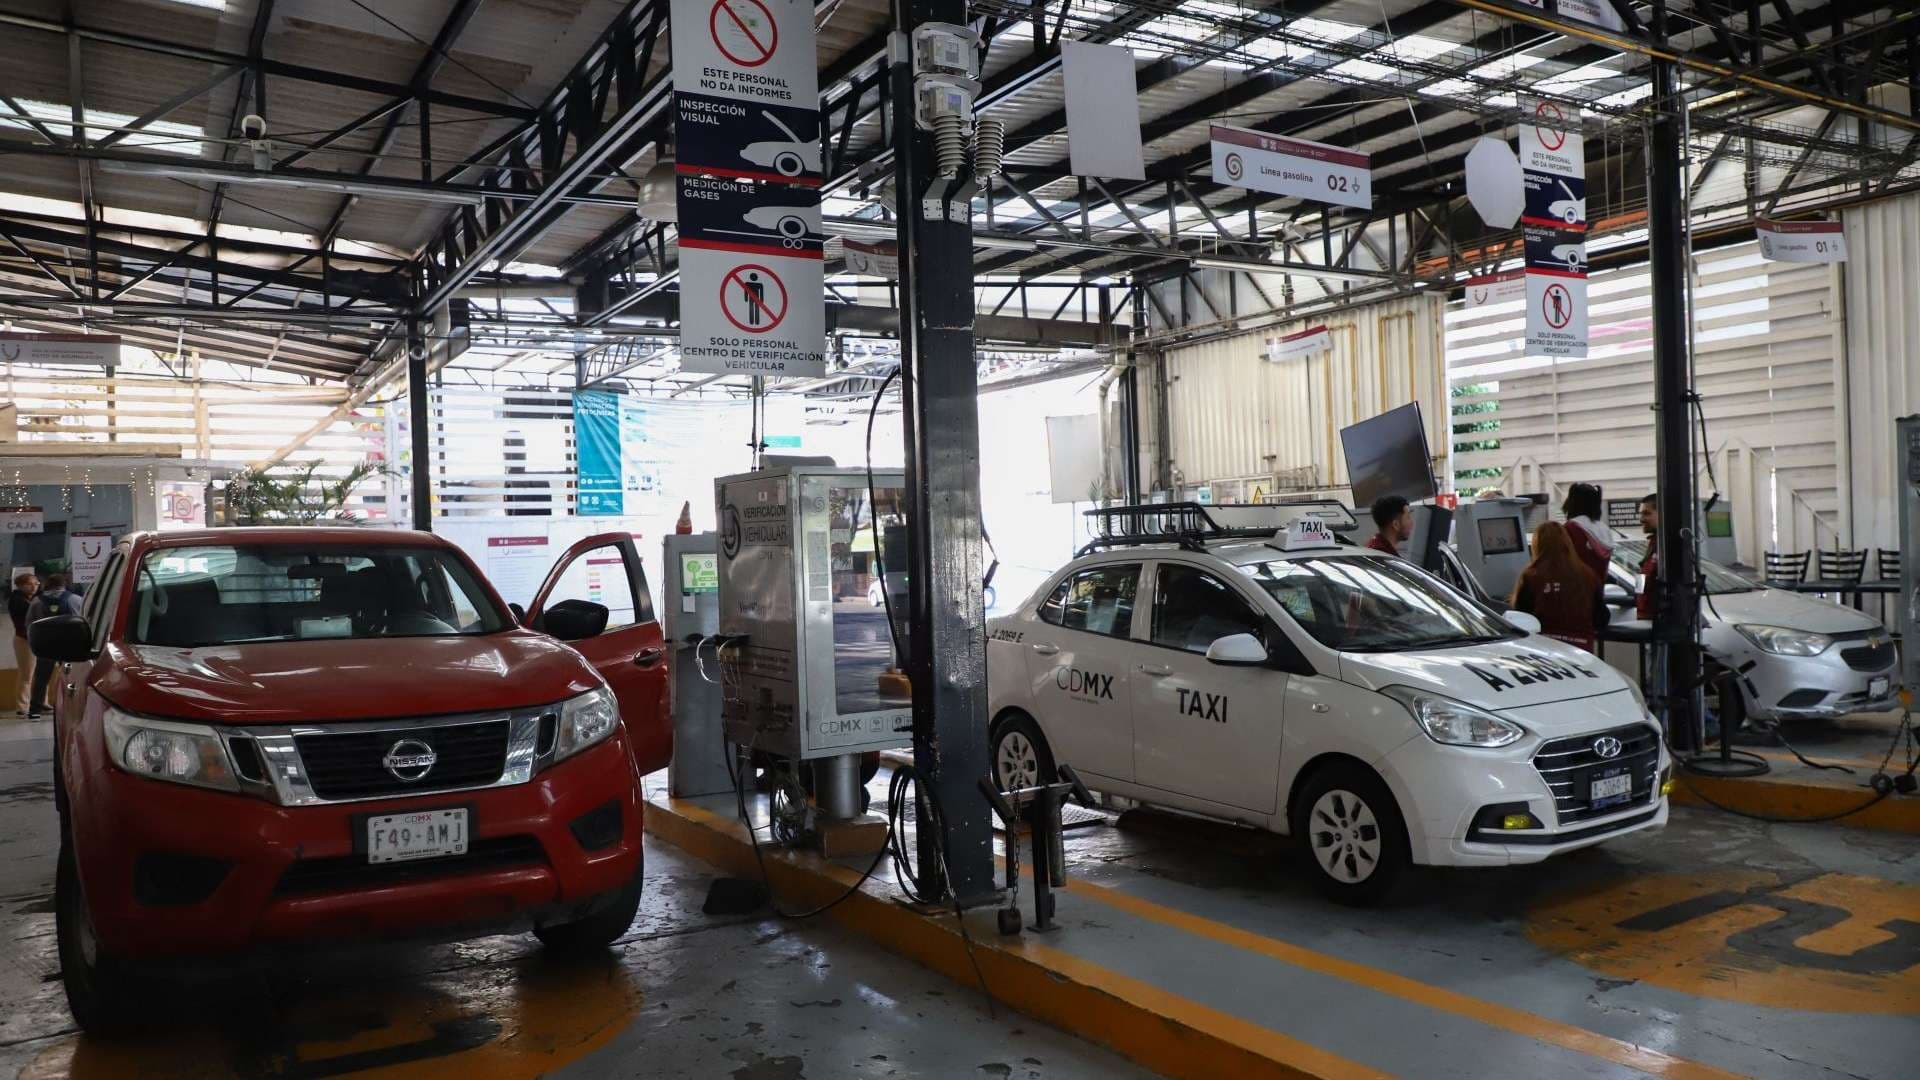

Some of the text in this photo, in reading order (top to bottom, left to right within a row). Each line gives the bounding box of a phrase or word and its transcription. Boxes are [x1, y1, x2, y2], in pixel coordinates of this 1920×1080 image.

[703, 67, 789, 89] ESTE PERSONAL
[700, 79, 792, 100] NO DA INFORMES
[680, 98, 746, 117] INSPECCIÓN
[680, 111, 720, 125] VISUAL
[1546, 153, 1571, 164] PERSONAL
[1548, 162, 1573, 173] INFORMES
[683, 178, 756, 194] MEDICIÓN DE
[1282, 170, 1314, 183] gasolina
[1327, 174, 1348, 192] 02
[684, 189, 720, 201] GASES
[1816, 241, 1828, 253] 01
[710, 337, 799, 350] SOLO PERSONAL
[1551, 332, 1576, 341] PERSONAL
[683, 346, 823, 362] CENTRO DE VERIFICACIÓN
[724, 360, 785, 371] VEHICULAR
[743, 503, 786, 519] VERIFICACIÓN
[7, 521, 38, 530] CAJA
[1300, 521, 1323, 533] TAXI
[743, 526, 787, 543] VEHICULAR
[1056, 666, 1114, 700] CDMX
[1462, 662, 1515, 692] A
[1176, 686, 1227, 724] TAXI
[819, 719, 862, 735] CDMX
[389, 755, 433, 767] NISSAN
[404, 813, 432, 824] CDMX
